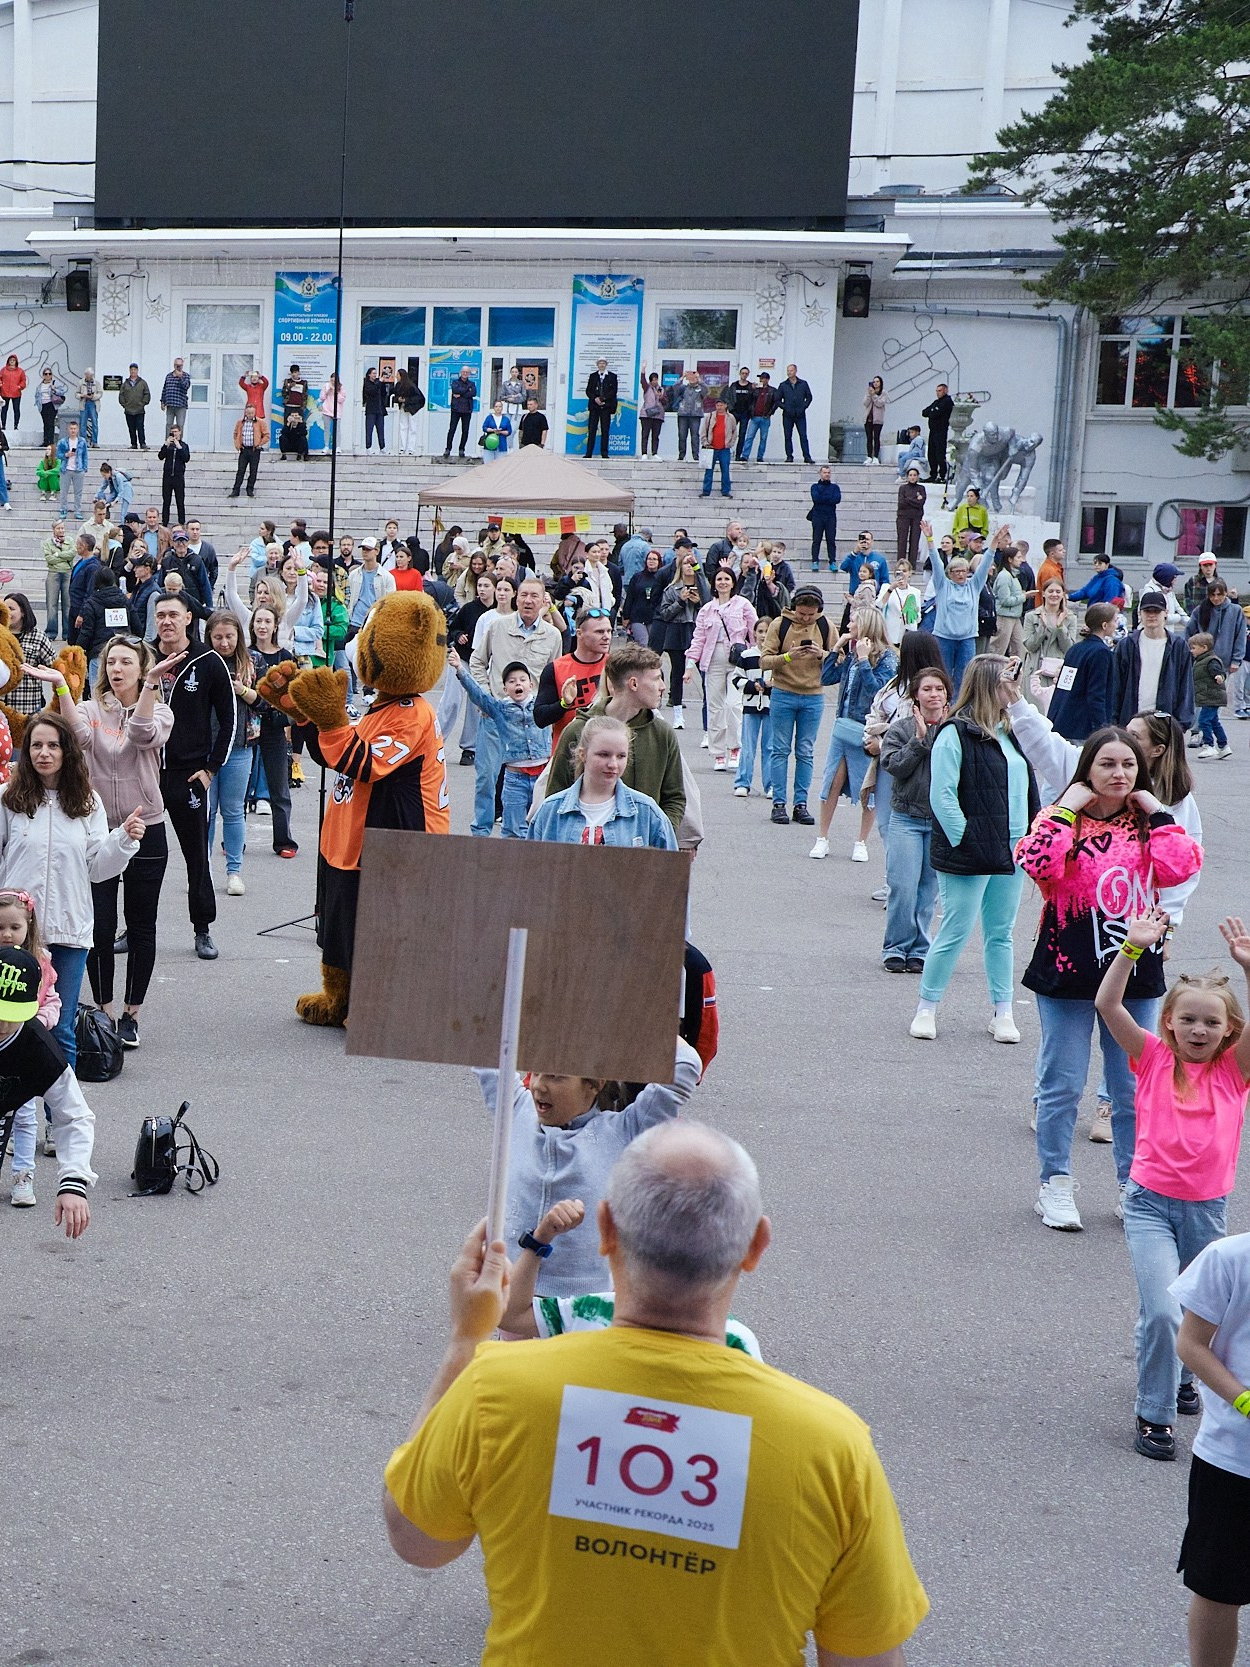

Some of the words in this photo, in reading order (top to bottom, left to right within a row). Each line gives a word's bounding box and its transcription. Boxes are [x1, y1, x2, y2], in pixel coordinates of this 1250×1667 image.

[280, 332, 303, 342] 09.00
[310, 332, 332, 342] 22.00
[109, 614, 124, 622] 149
[370, 735, 411, 765] 27
[576, 1435, 719, 1508] 103
[575, 1498, 631, 1515] УЧАСТНИК
[633, 1508, 684, 1525] РЕКОРДА
[687, 1518, 715, 1532] 2025
[575, 1535, 717, 1575] ВОЛОНТЁР
